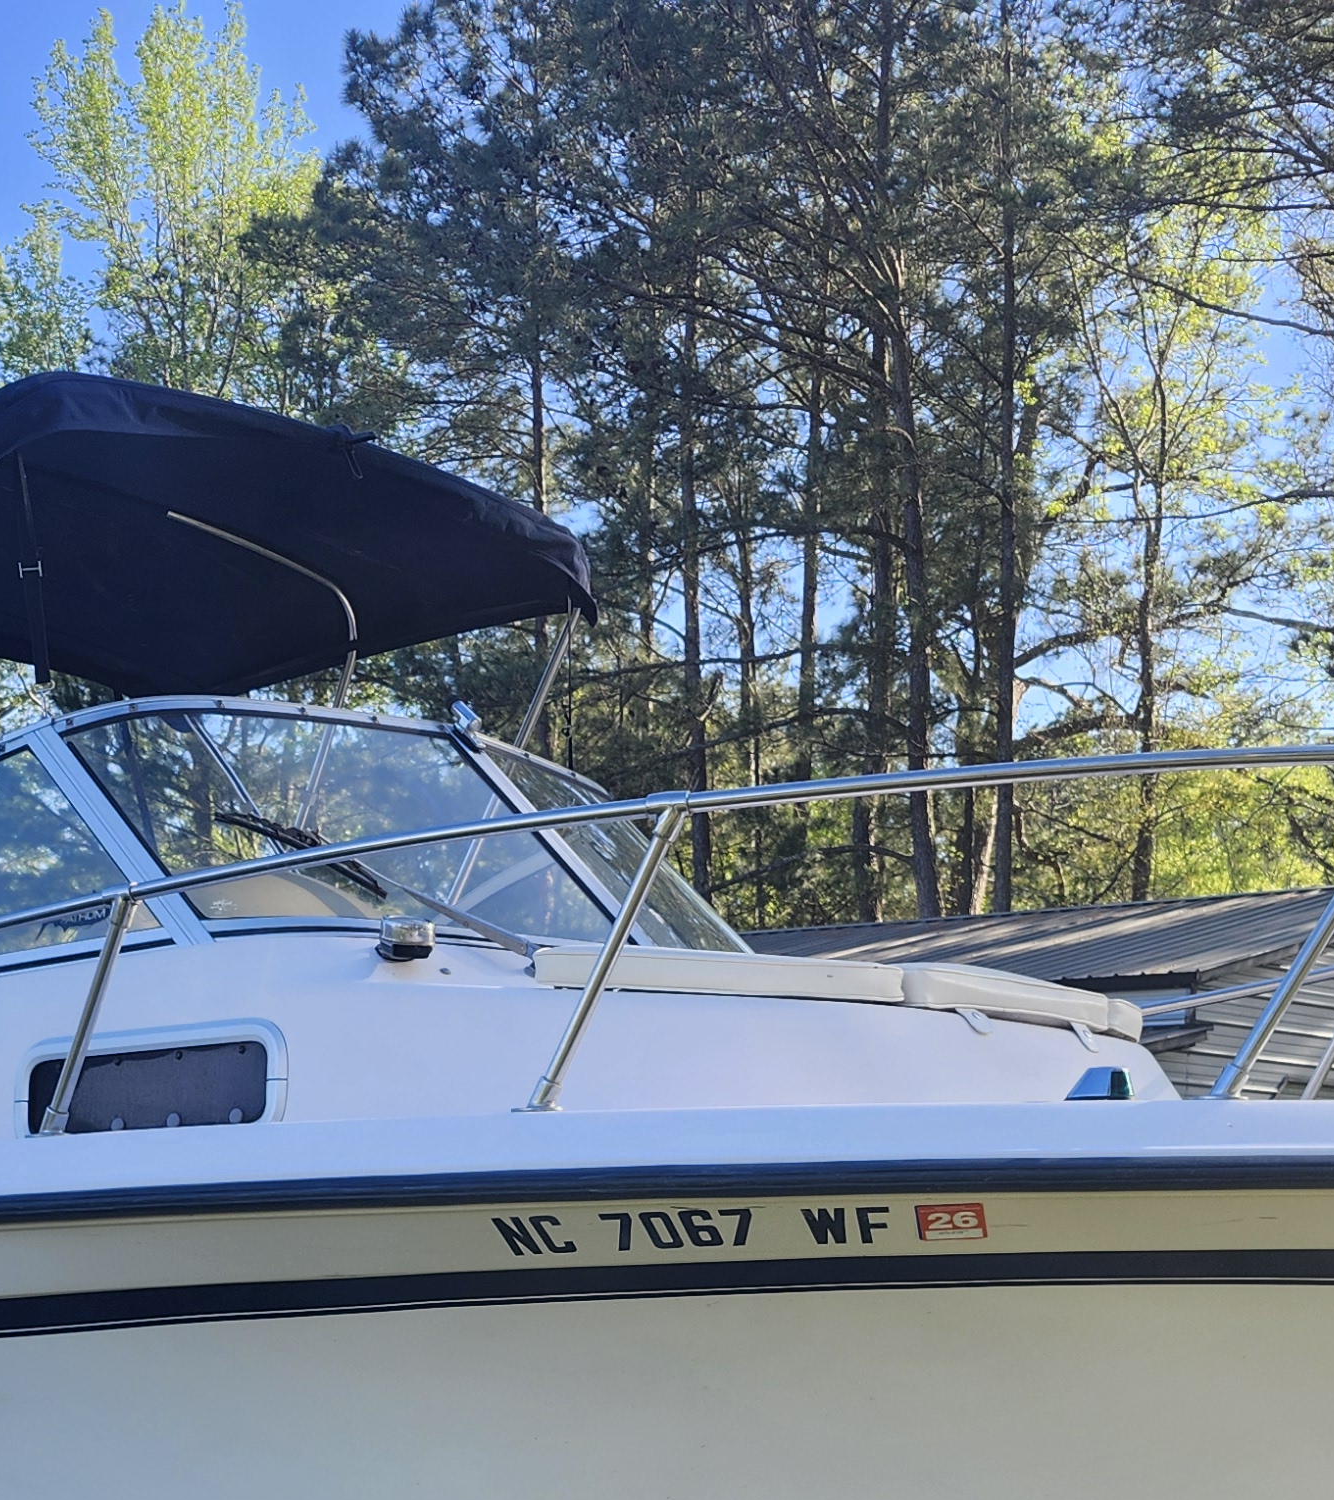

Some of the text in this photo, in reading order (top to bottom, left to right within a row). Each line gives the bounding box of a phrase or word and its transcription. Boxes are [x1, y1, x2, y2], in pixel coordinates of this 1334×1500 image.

[491, 1206, 889, 1256] NC 7067 WF
[927, 1211, 979, 1230] 26
